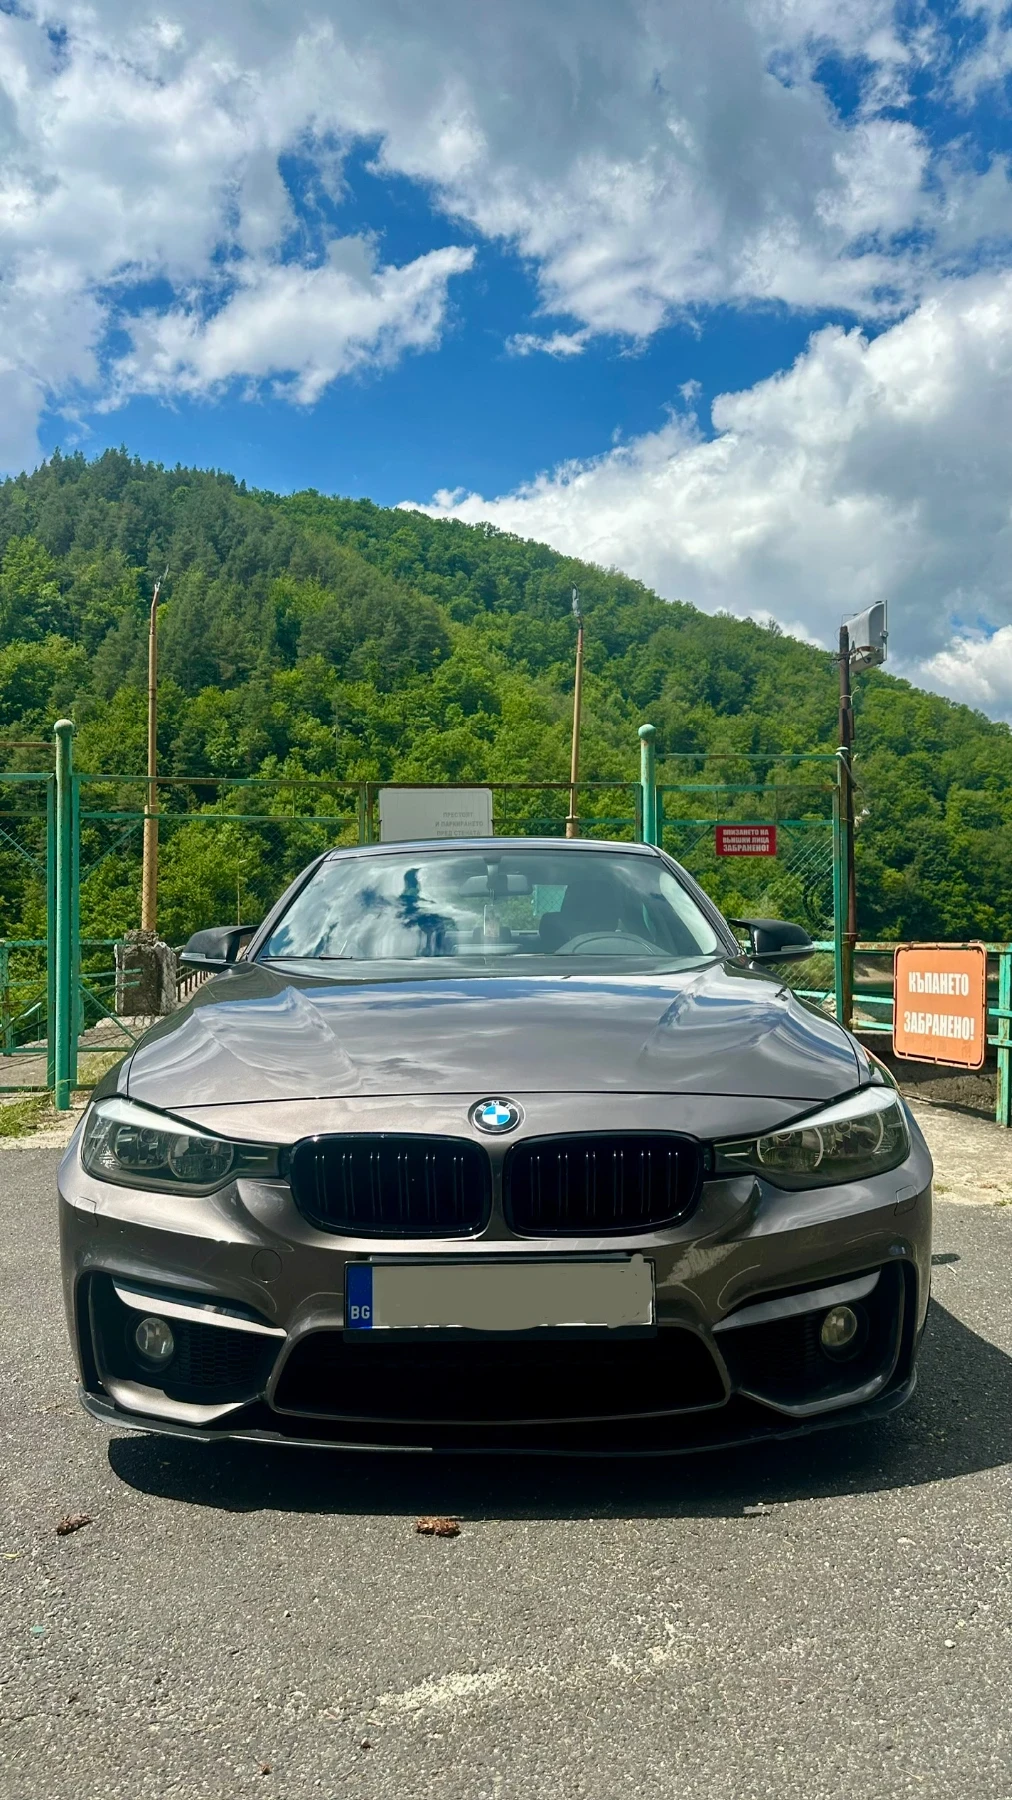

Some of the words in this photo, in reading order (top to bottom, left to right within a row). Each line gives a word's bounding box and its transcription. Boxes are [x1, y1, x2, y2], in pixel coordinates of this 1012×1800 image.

[908, 971, 969, 996] КЪПАНЕТО
[904, 1011, 975, 1040] ЗАБРАНЕНО!
[351, 1305, 370, 1320] BG
